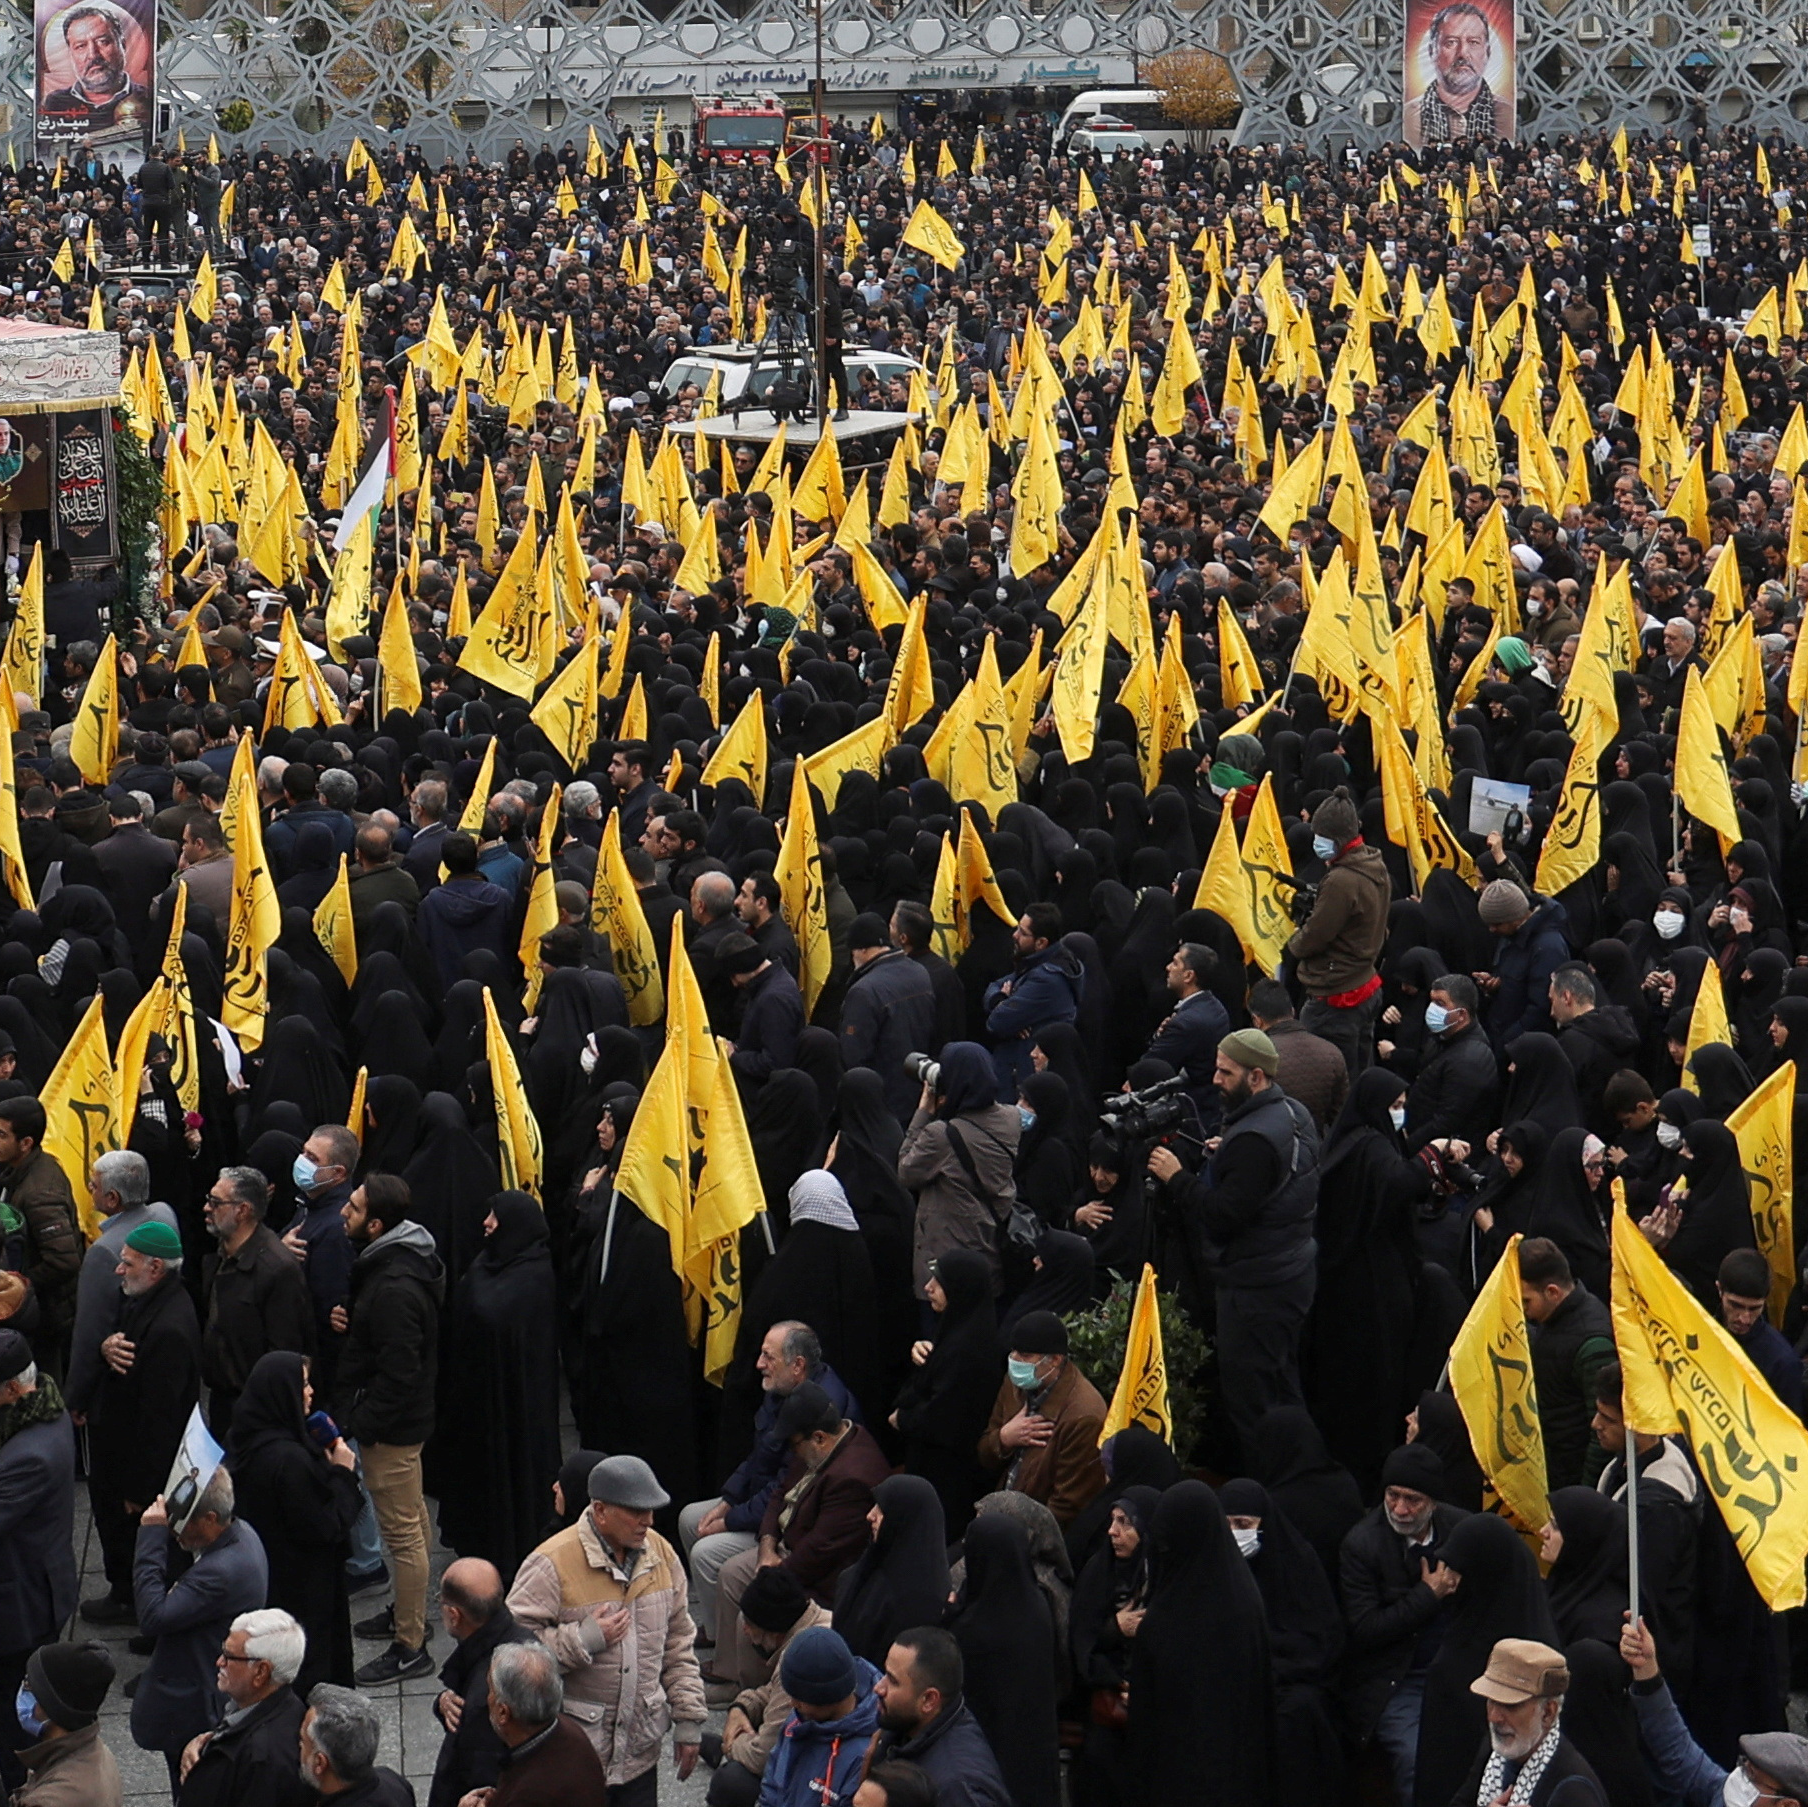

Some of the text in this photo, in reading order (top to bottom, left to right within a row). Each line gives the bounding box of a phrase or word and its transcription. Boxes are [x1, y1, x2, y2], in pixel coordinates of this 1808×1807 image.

[716, 66, 807, 87] فروشگاه گیلان
[854, 69, 890, 87] جواهری
[906, 63, 999, 85] فروشگاه الغدیر
[1018, 59, 1101, 83] بنکدار
[637, 72, 696, 94] جواهری
[38, 104, 90, 118] شهید
